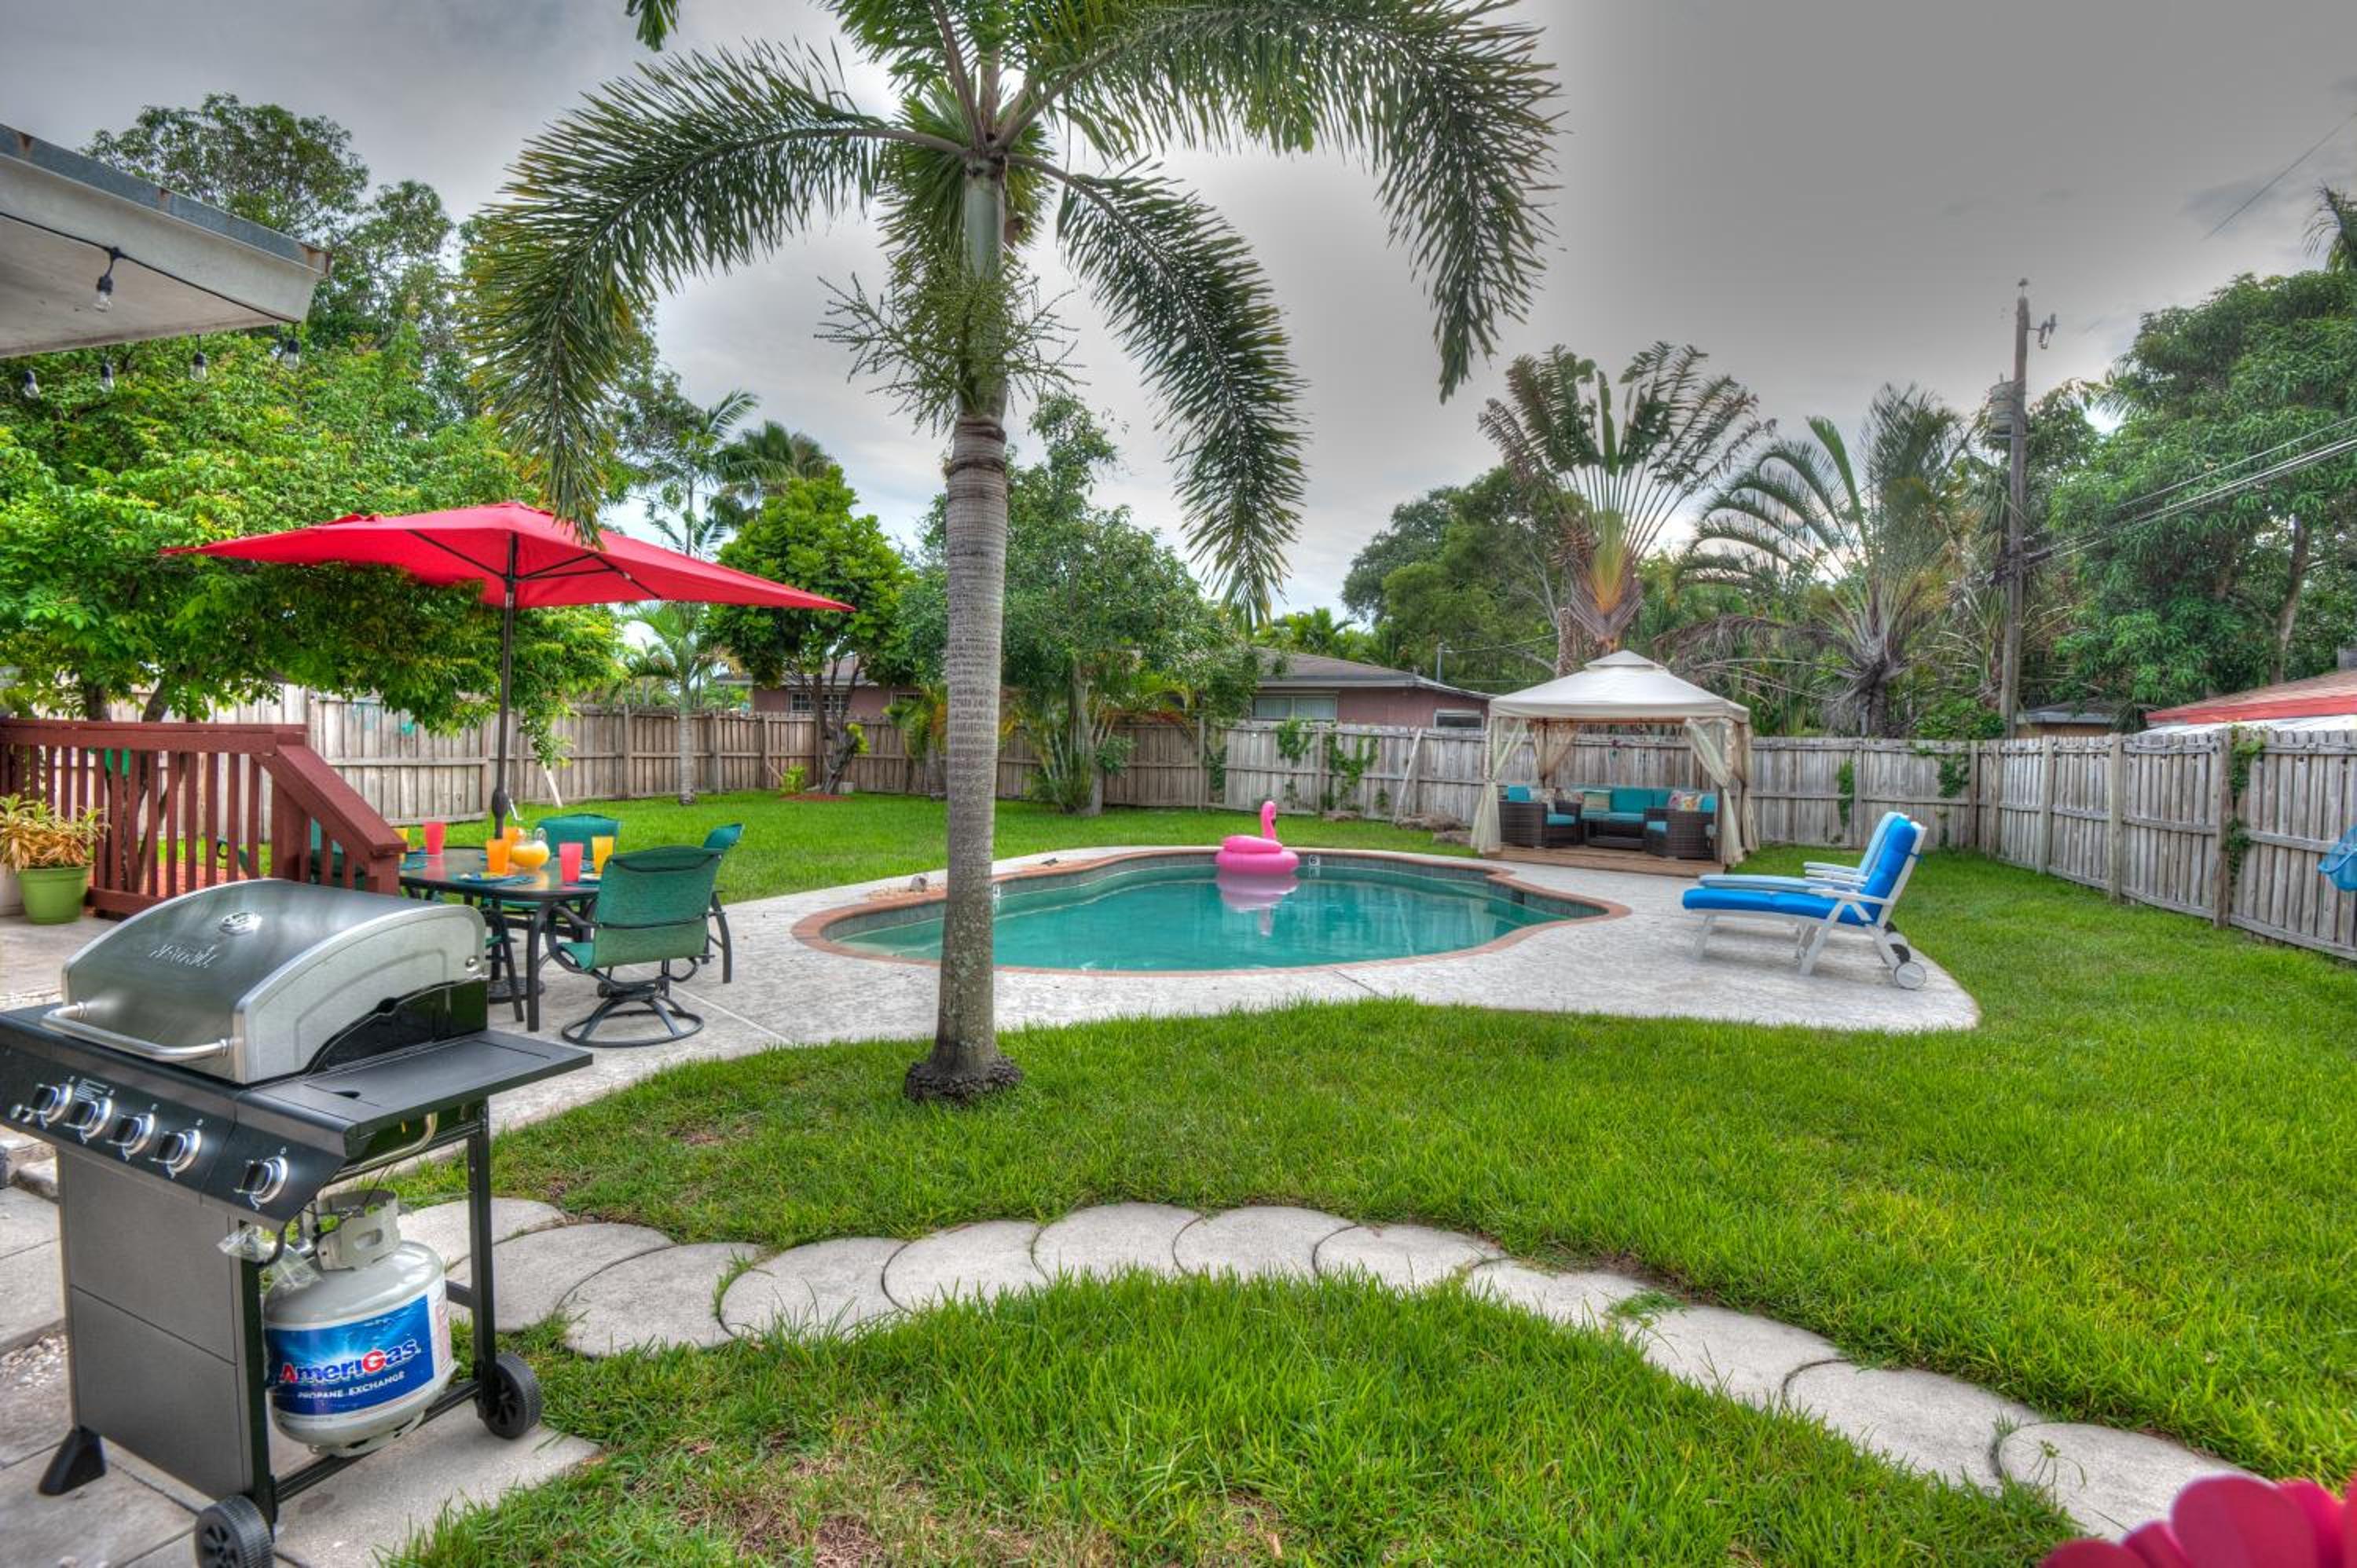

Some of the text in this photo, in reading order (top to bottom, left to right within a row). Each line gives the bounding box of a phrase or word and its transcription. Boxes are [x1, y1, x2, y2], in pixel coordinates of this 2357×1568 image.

[279, 1338, 418, 1384] AmeriGas
[297, 1371, 405, 1400] PROPANE EXCHANGE
